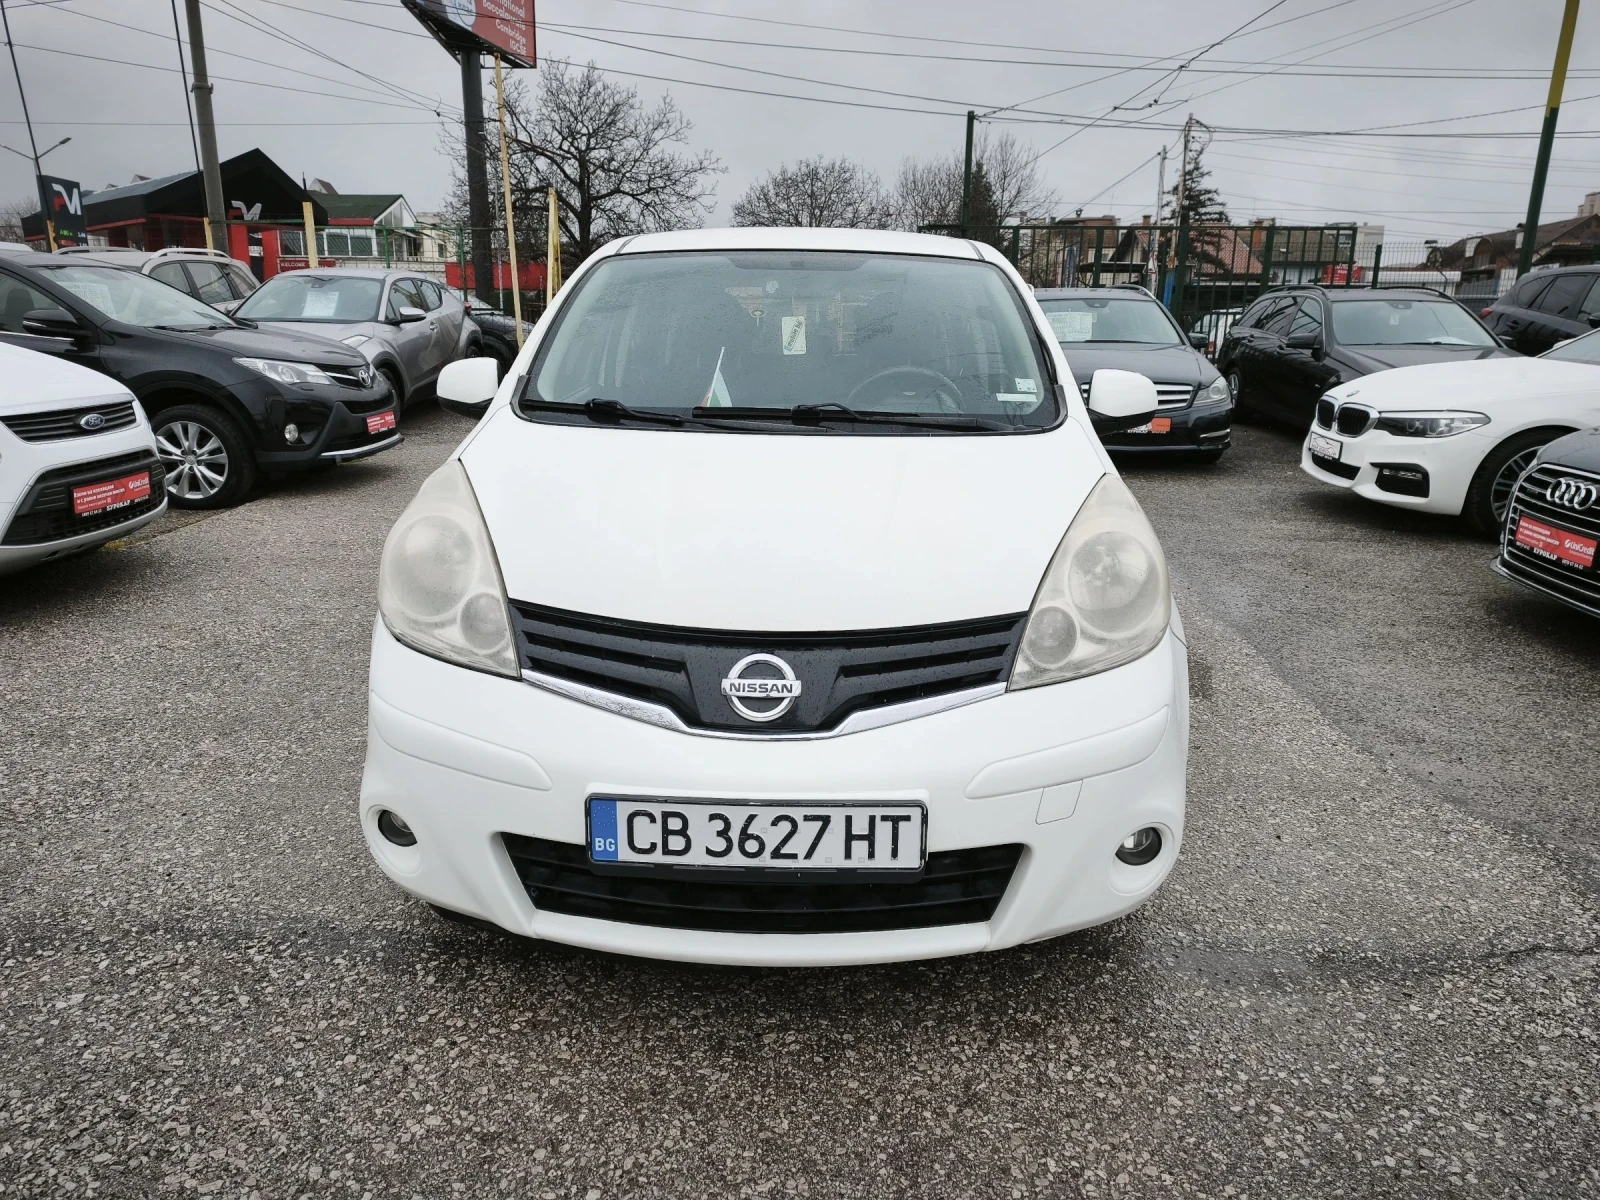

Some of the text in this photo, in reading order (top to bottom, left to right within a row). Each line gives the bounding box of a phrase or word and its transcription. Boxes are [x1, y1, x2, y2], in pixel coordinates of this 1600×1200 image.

[496, 19, 526, 44] Cambridge
[510, 39, 527, 56] IGCSE
[1570, 541, 1595, 555] UniCredit
[729, 682, 793, 693] NISSAN
[627, 809, 912, 861] CB 3627 HT
[595, 838, 615, 851] BG
